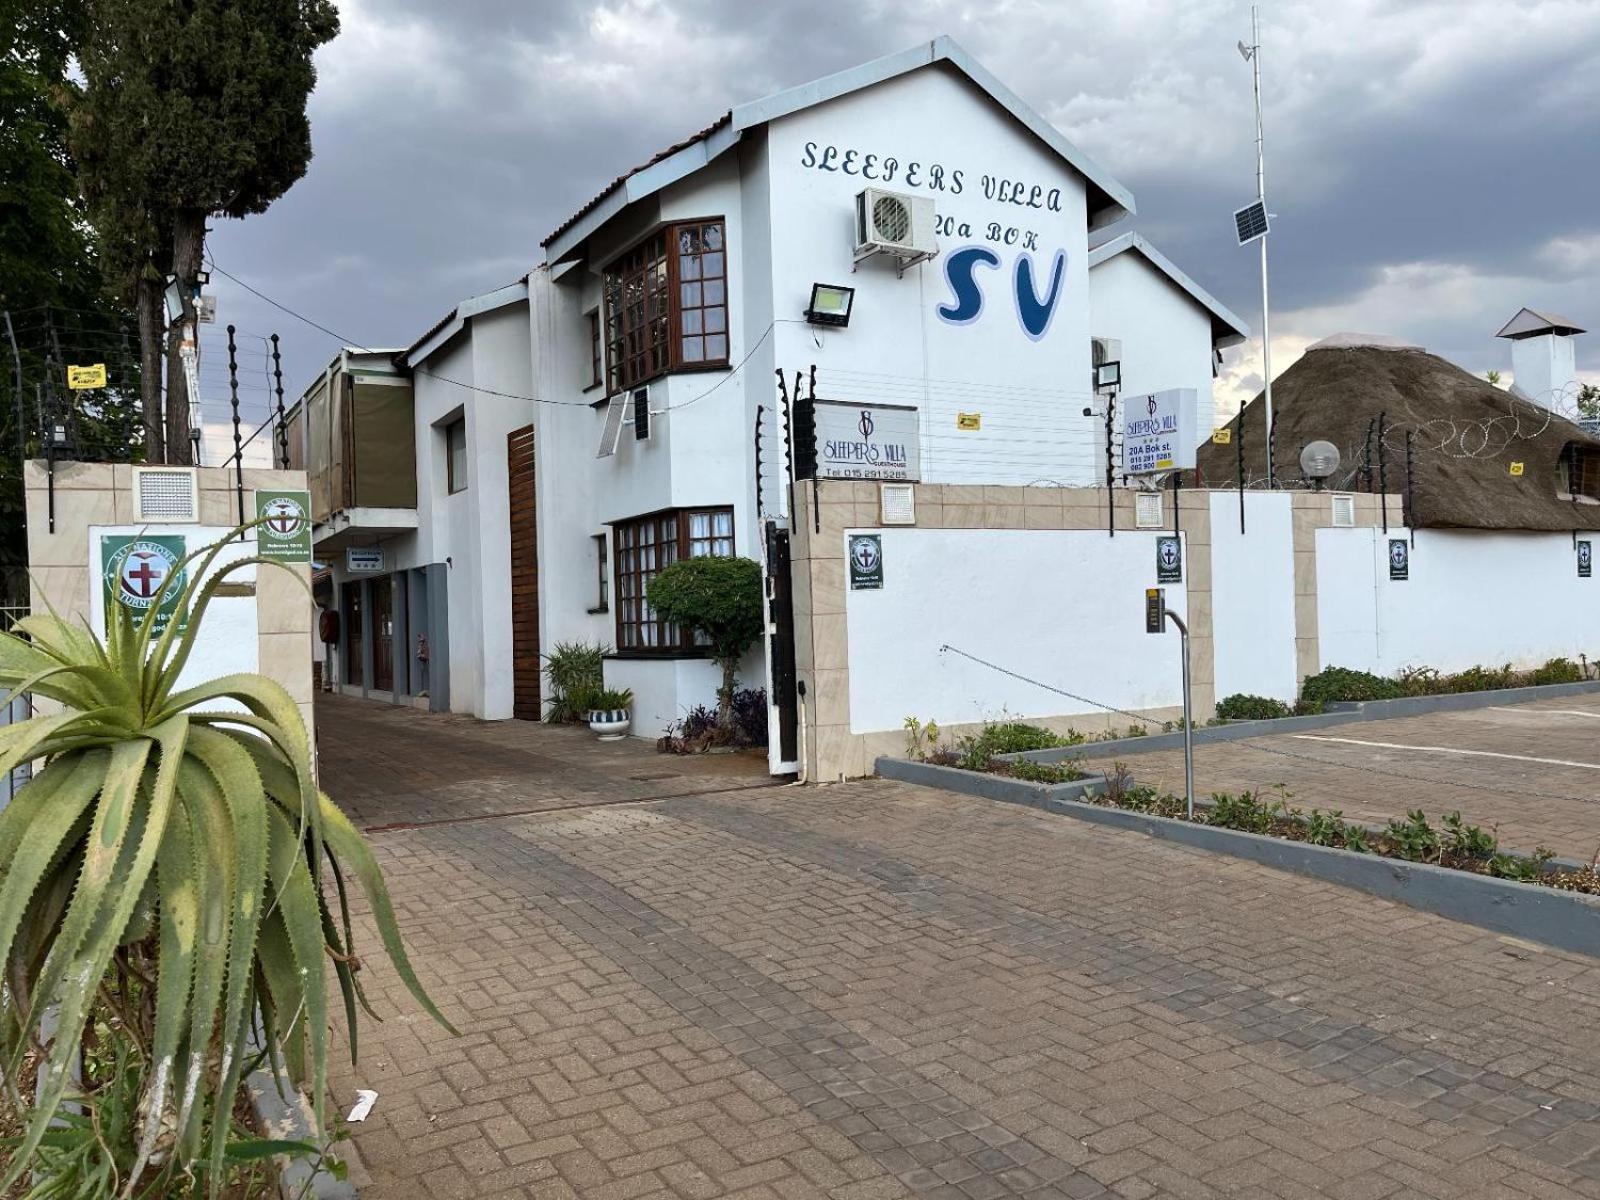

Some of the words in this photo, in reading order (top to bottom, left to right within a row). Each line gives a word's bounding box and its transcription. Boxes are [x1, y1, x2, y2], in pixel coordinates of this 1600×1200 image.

[801, 142, 964, 195] SLEEPERS
[981, 174, 1063, 212] VILLA
[985, 222, 1039, 251] BOK
[935, 244, 1067, 342] SV
[823, 440, 879, 464] SLEEPERS
[884, 444, 907, 462] VILLA
[1129, 446, 1144, 456] 20A
[1145, 443, 1160, 453] Bok
[1162, 442, 1172, 451] st.
[133, 543, 175, 563] NATIONS
